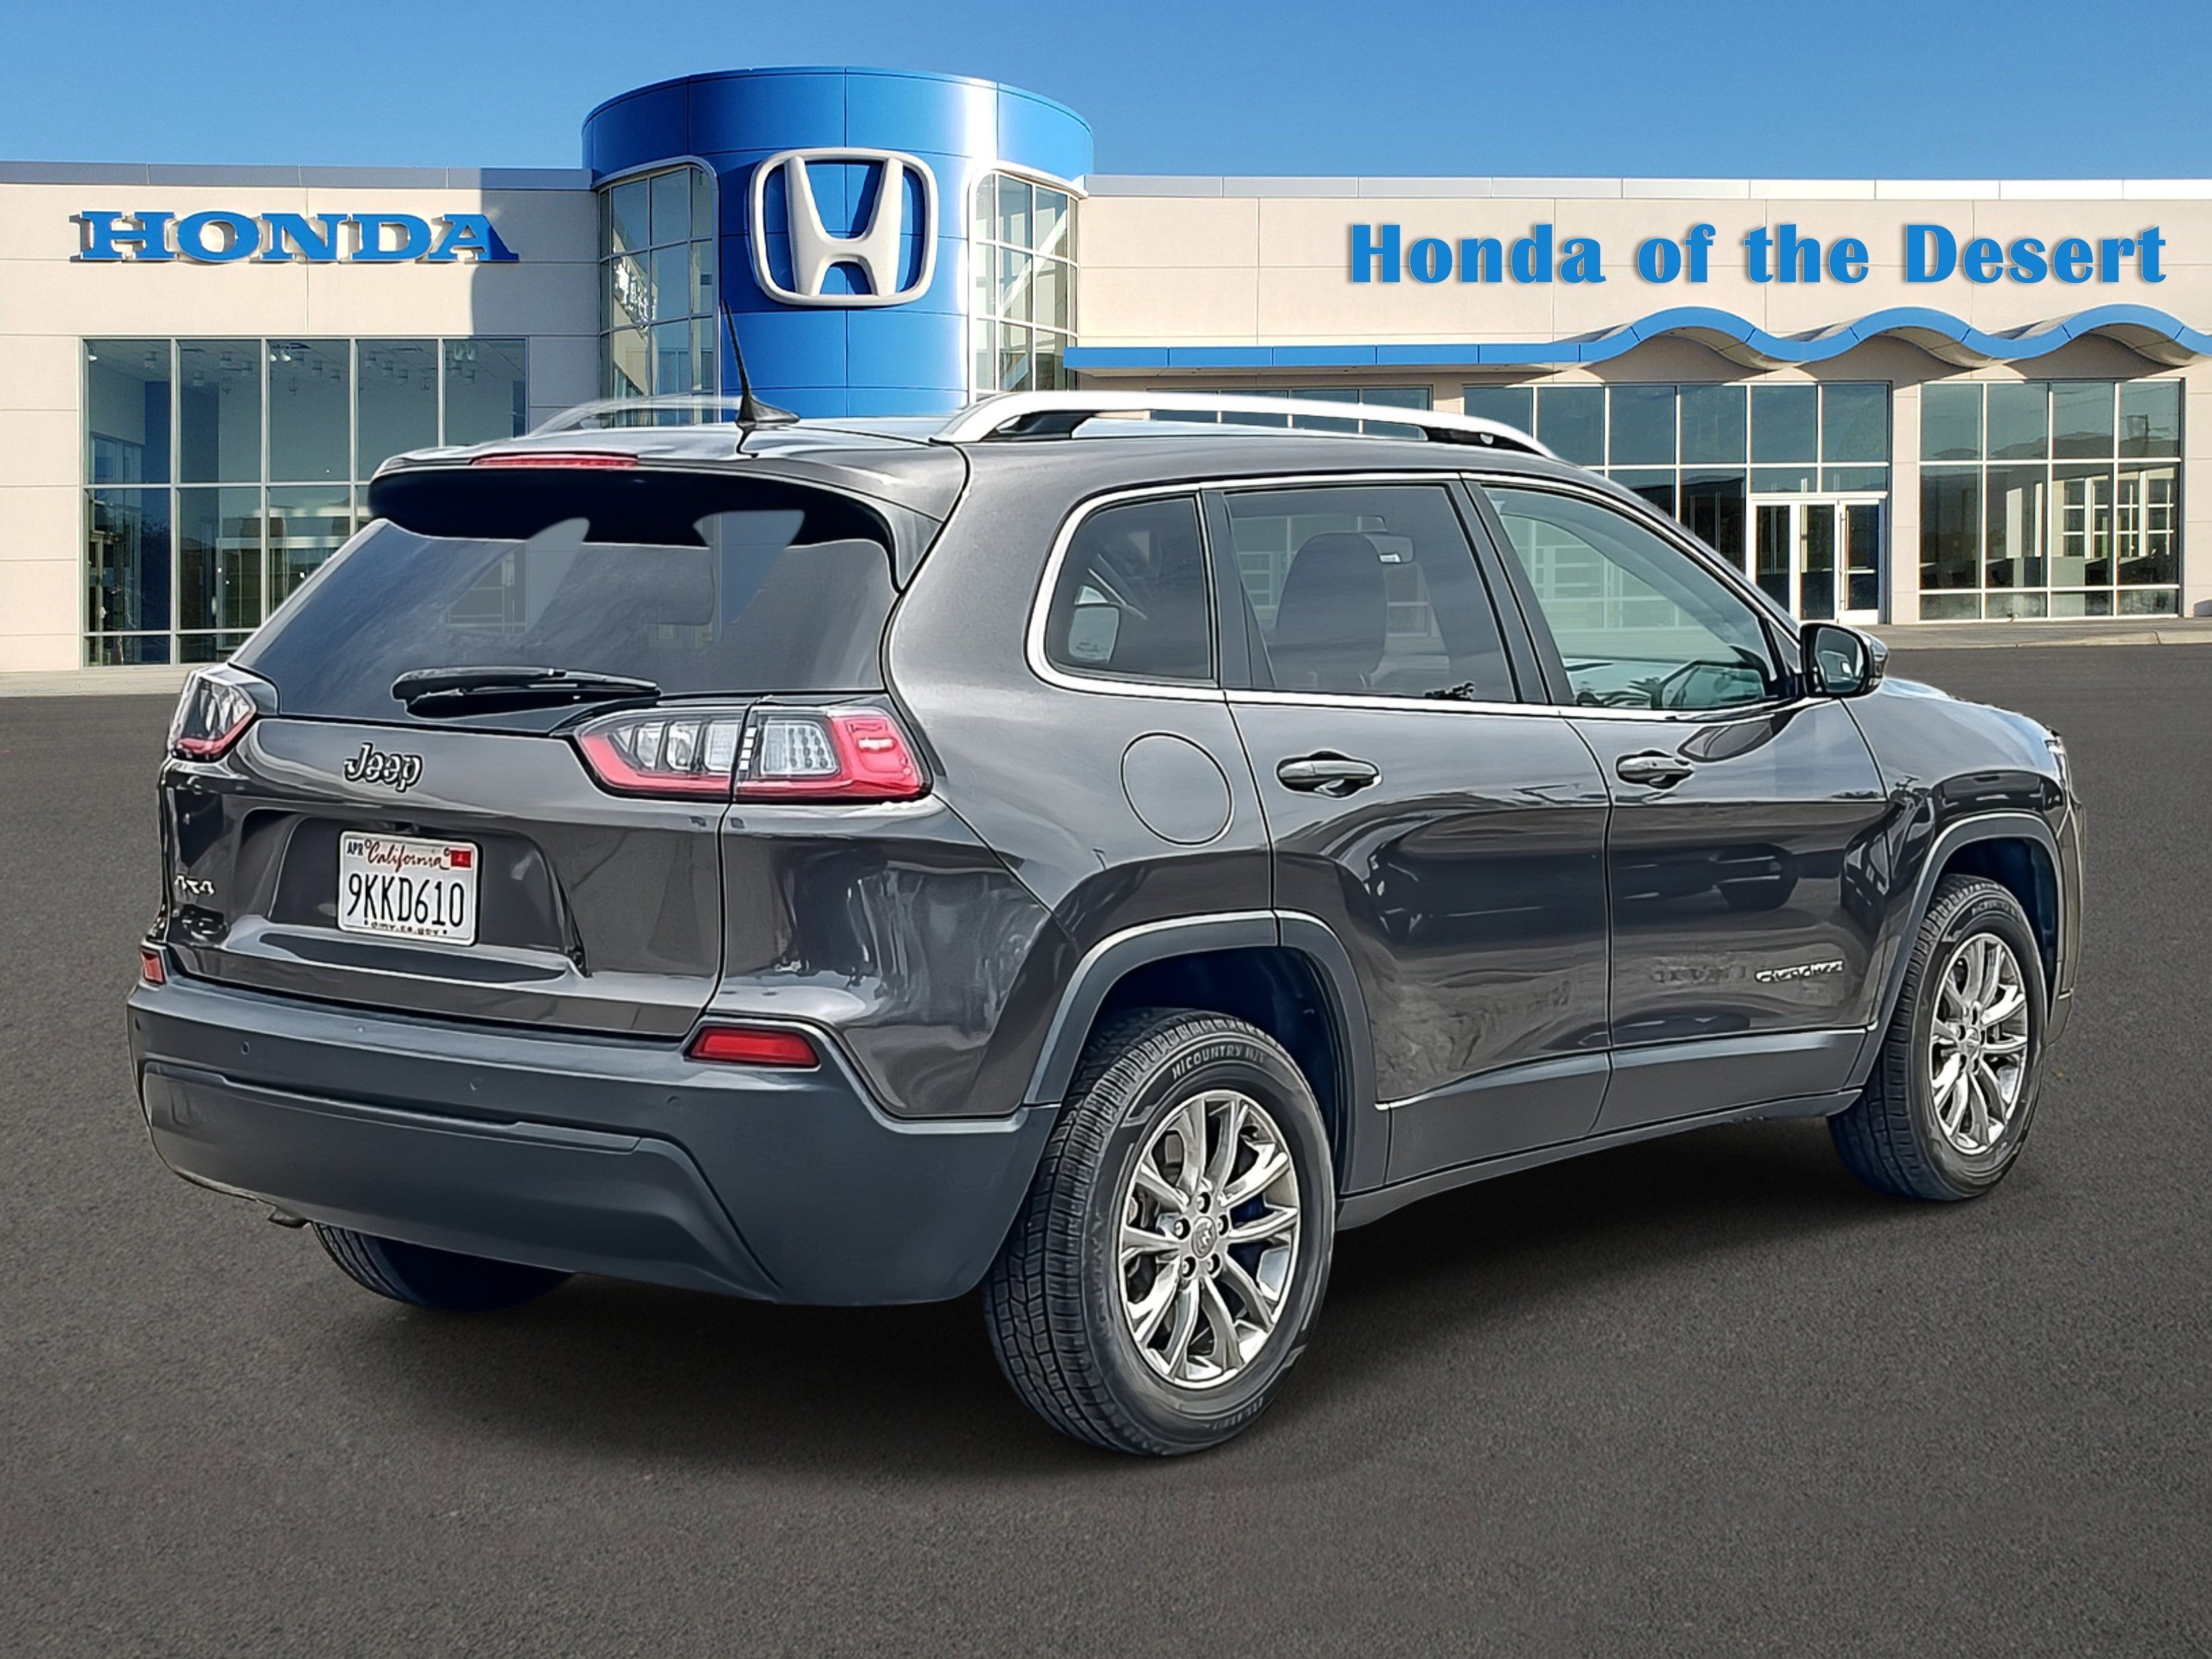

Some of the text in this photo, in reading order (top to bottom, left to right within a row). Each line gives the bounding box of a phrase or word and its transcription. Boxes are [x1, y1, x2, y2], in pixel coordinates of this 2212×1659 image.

[80, 210, 519, 262] HONDA
[1351, 225, 2167, 283] Honda of the Desert
[344, 742, 423, 793] Jeep
[347, 841, 363, 856] APR
[367, 841, 450, 873] California
[347, 873, 464, 927] 9KKD610
